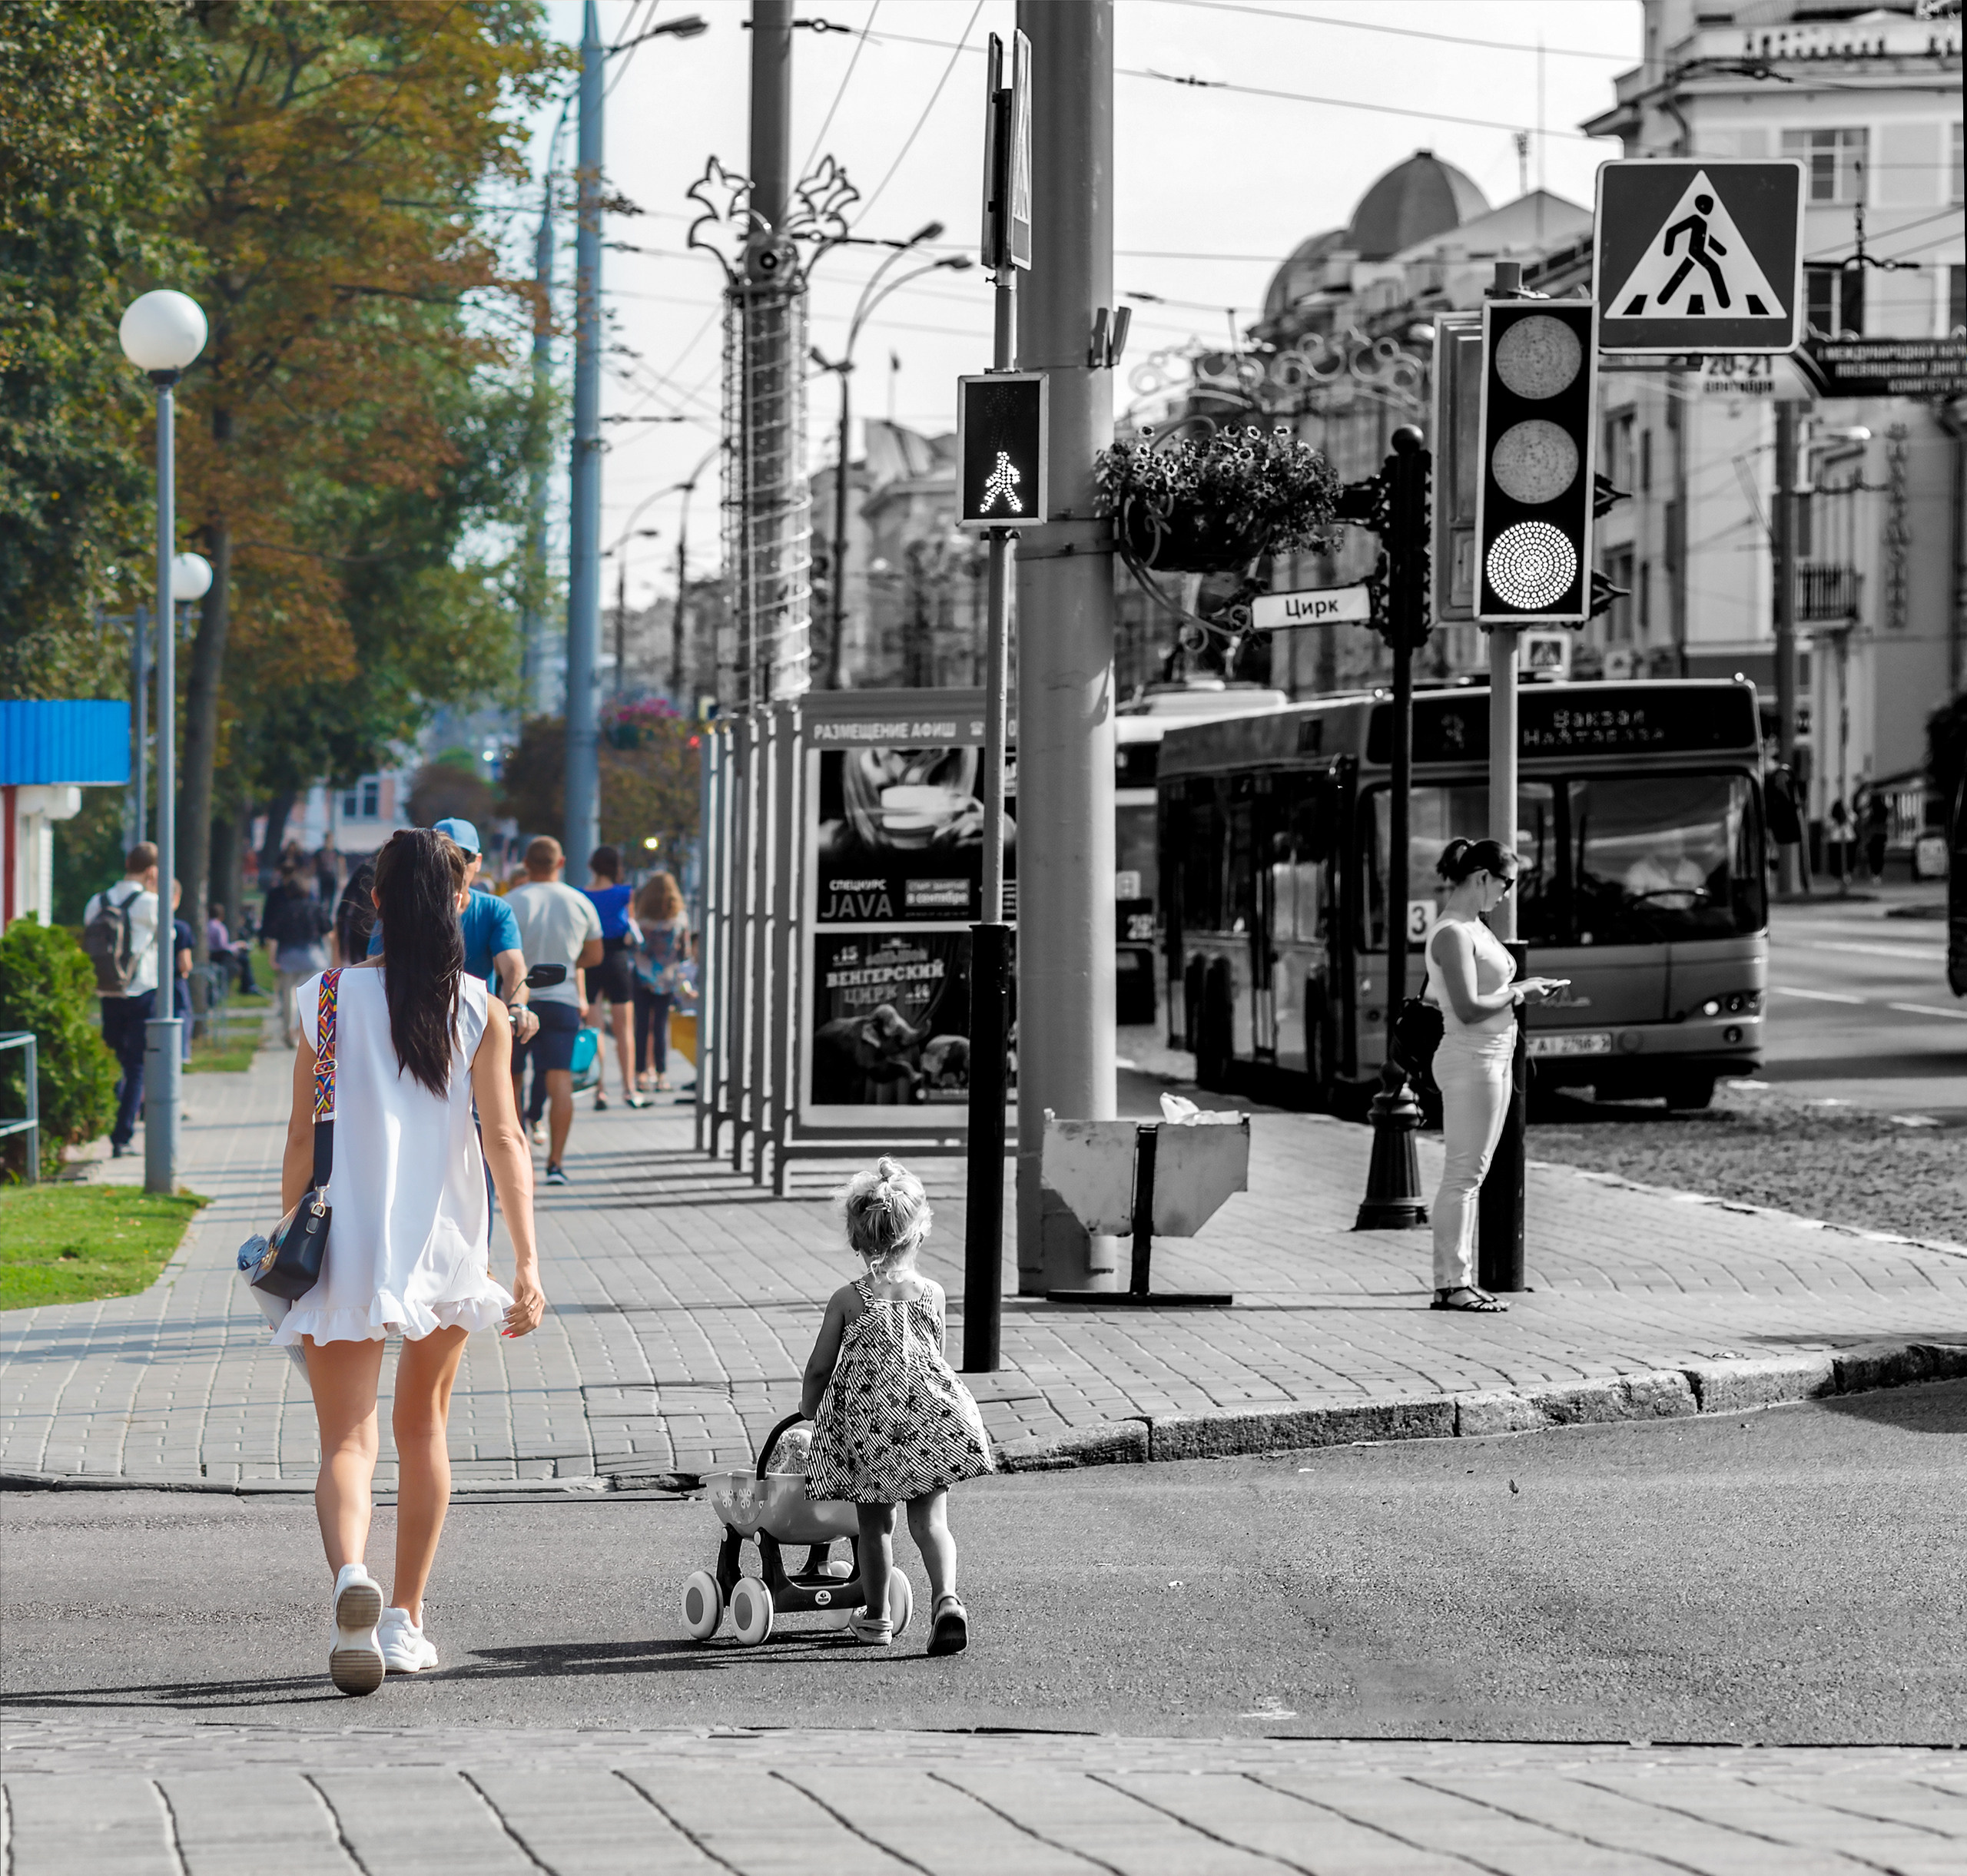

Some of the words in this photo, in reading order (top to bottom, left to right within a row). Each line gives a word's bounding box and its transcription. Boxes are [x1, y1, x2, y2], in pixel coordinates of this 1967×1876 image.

[1285, 598, 1338, 618] Цирк
[814, 722, 908, 741] РАЗМЕЩЕНИЕ
[911, 722, 956, 737] АФИШ
[829, 879, 887, 892] СПЕЦКУРС
[821, 893, 894, 918] JAVA
[1411, 906, 1427, 936] 3
[826, 959, 944, 988] ВЕНГЕРСКИЙ
[844, 984, 897, 1008] ЦИРК
